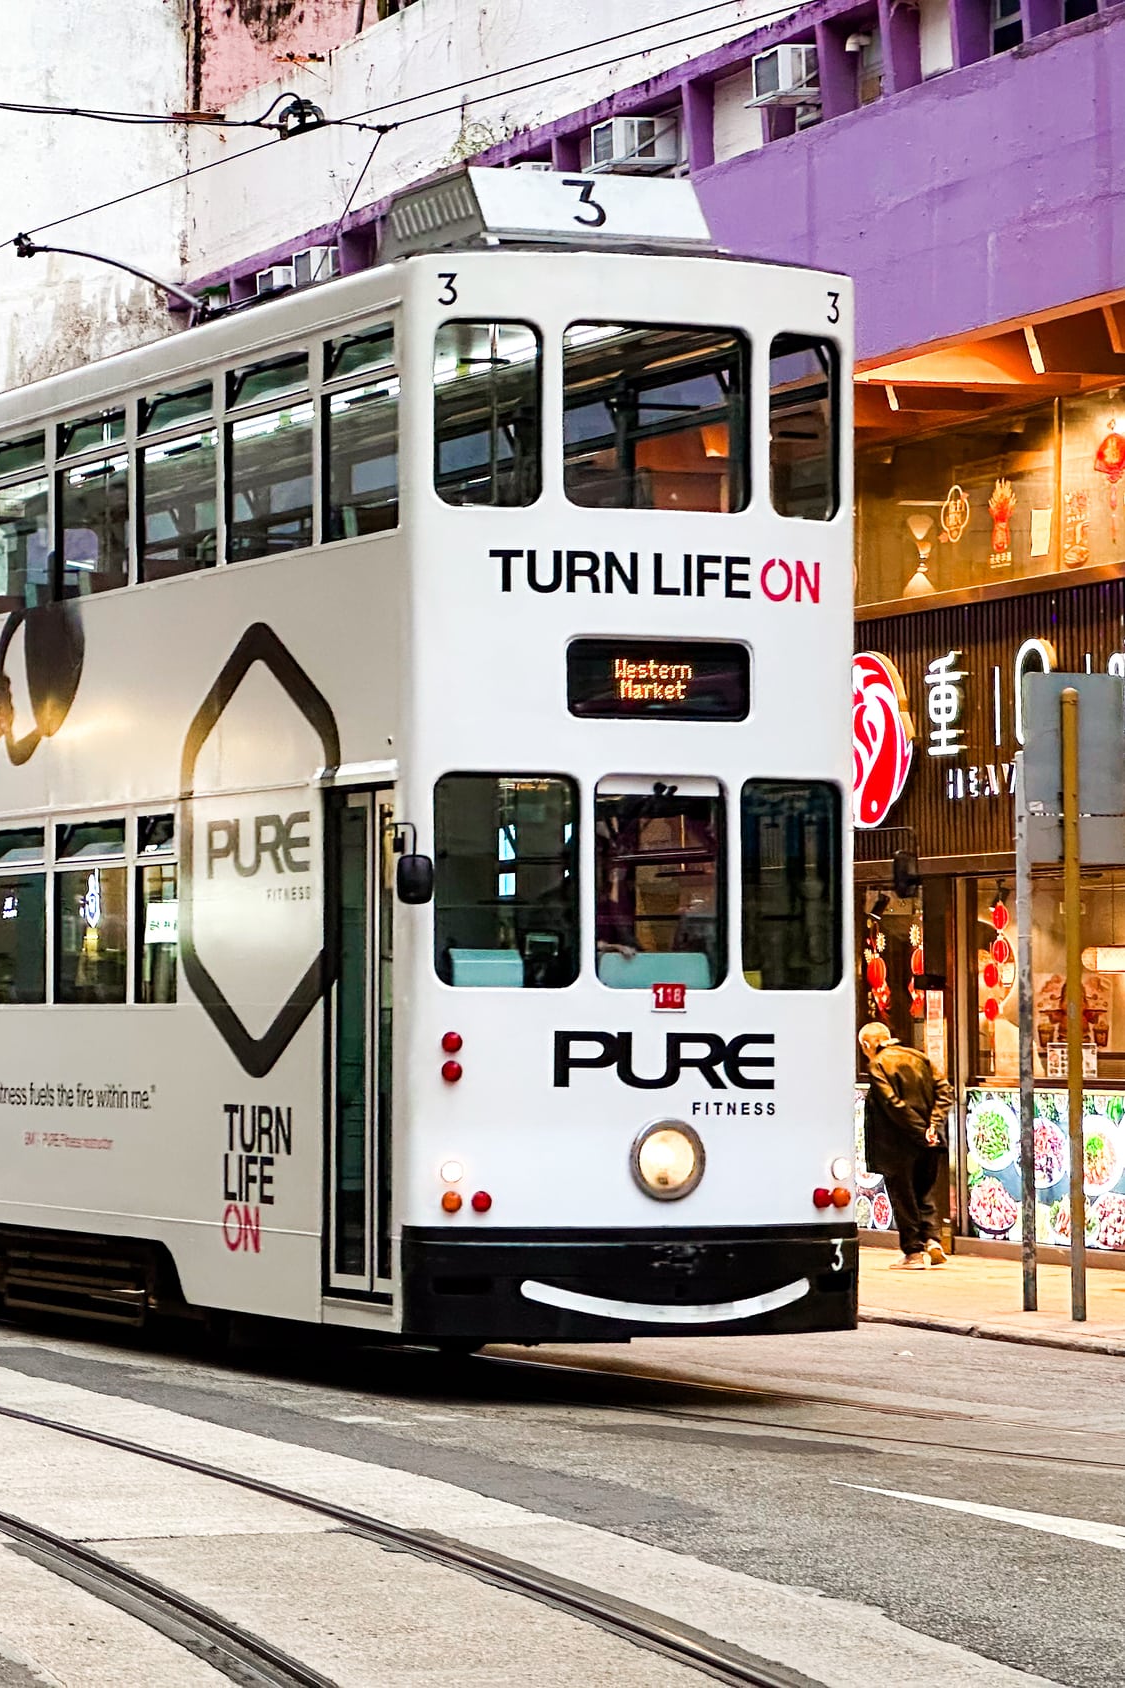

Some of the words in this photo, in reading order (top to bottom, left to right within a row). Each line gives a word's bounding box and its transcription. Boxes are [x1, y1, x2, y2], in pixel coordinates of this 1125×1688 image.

[561, 179, 606, 227] 3
[437, 272, 458, 305] 3
[826, 291, 840, 324] 3
[488, 549, 639, 595] TURN
[653, 552, 751, 599] LIFE
[760, 558, 820, 604] ON
[614, 658, 693, 679] Western
[619, 679, 687, 699] Market
[207, 810, 311, 880] PURE
[553, 1030, 775, 1090] PURE
[29, 1081, 55, 1107] fuels
[57, 1083, 74, 1108] the
[76, 1082, 94, 1108] fire
[692, 1102, 776, 1116] FITNESS
[223, 1103, 292, 1156] TURN
[223, 1153, 275, 1205] LIFE
[222, 1203, 261, 1254] ON
[829, 1237, 844, 1272] 3
